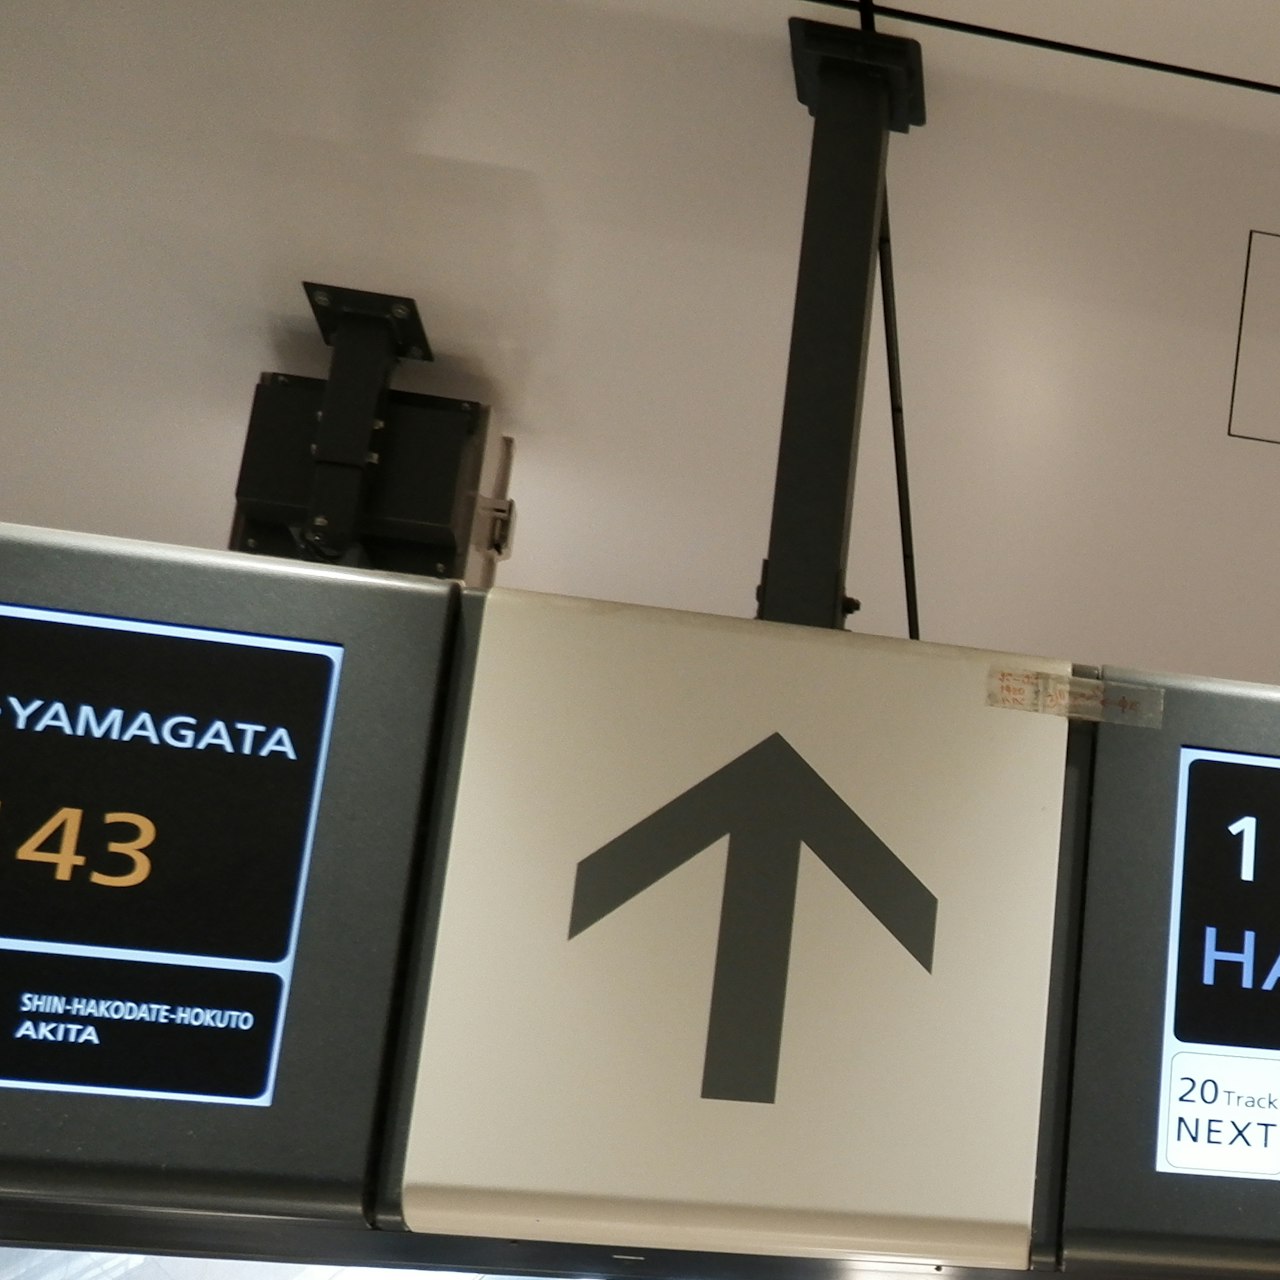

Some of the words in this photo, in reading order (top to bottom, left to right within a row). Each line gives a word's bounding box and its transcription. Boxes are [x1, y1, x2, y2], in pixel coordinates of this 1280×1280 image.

[0, 696, 297, 760] YAMAGATA
[0, 802, 156, 887] 43
[20, 992, 255, 1031] SHIN-HAKODATE-HOKUTO
[14, 1019, 100, 1045] AKITA
[1178, 1077, 1218, 1105] 20
[1223, 1089, 1279, 1110] Track
[1176, 1116, 1277, 1148] NEXT
